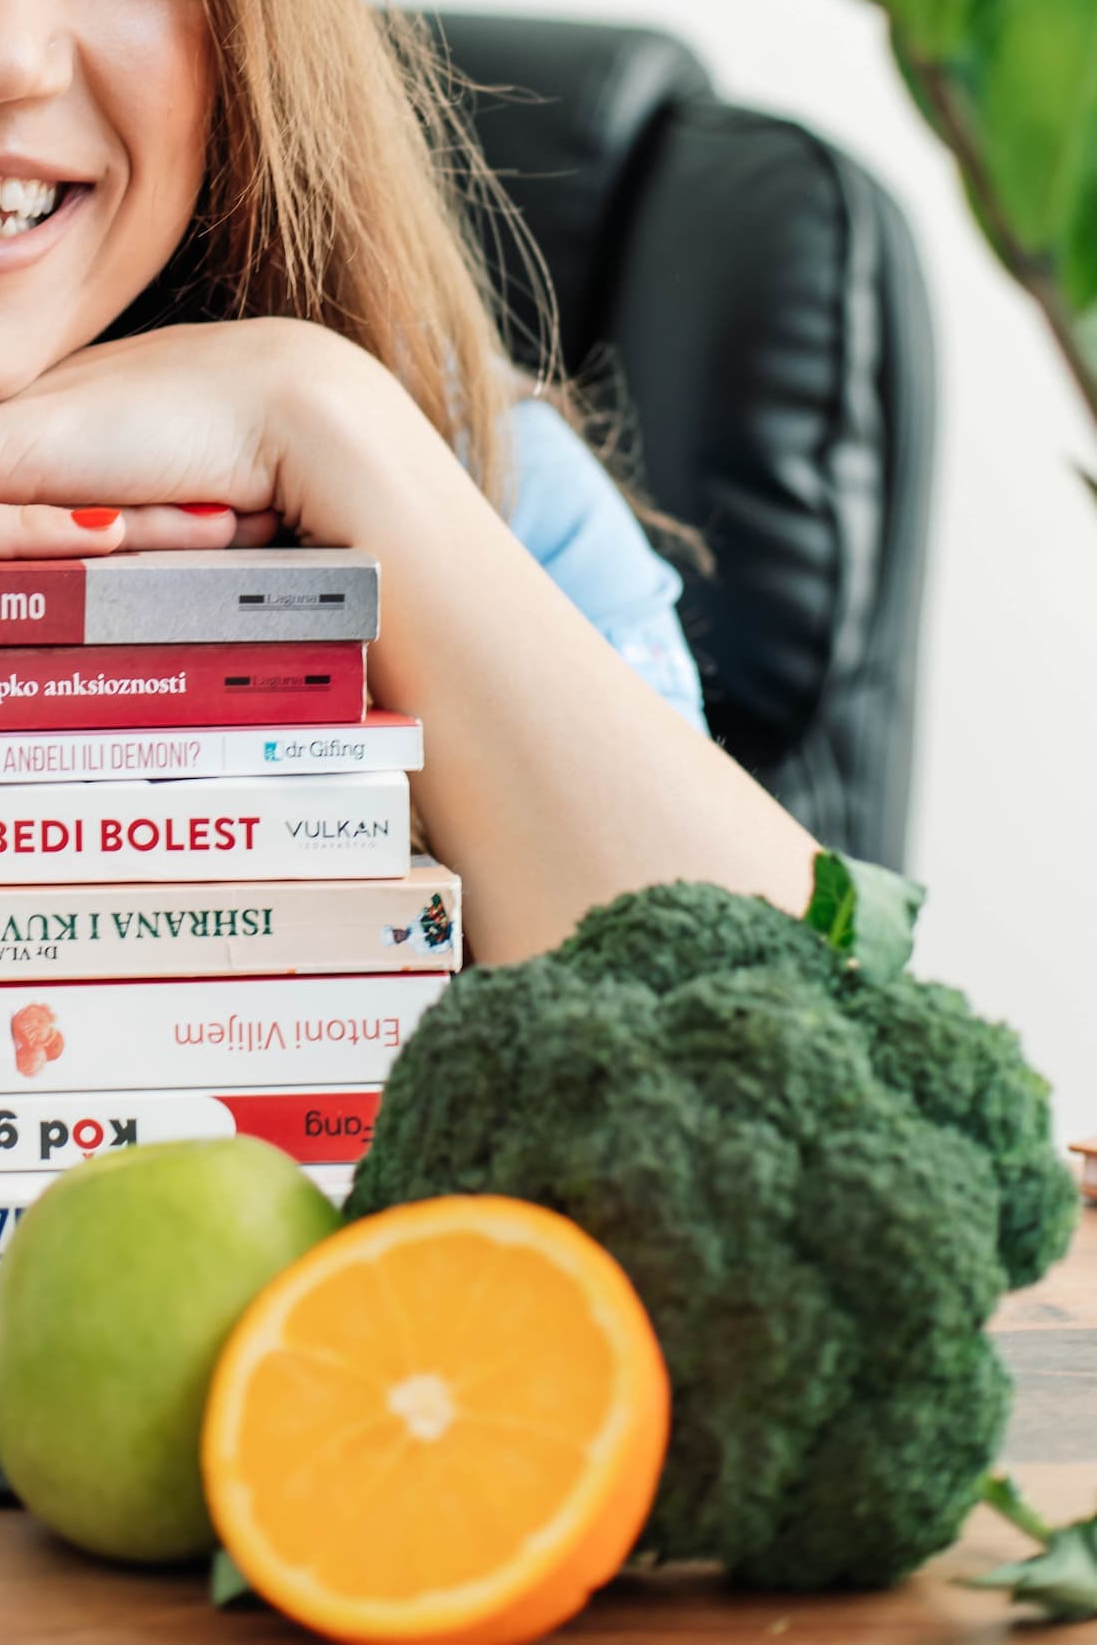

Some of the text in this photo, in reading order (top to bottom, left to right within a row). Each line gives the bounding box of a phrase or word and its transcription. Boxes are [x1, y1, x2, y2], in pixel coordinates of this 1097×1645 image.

[43, 671, 189, 697] anksioznosti
[2, 745, 77, 773] ANĐELI
[81, 745, 105, 772] ILI
[111, 739, 202, 772] DEMONI?
[285, 739, 365, 764] dr Gifing
[99, 816, 261, 853] BOLEST
[284, 819, 390, 839] VULKAN
[89, 912, 100, 940] I
[100, 907, 274, 940] ISHRANA
[33, 944, 60, 961] Dr
[174, 1014, 401, 1052] Entoni Vilijem
